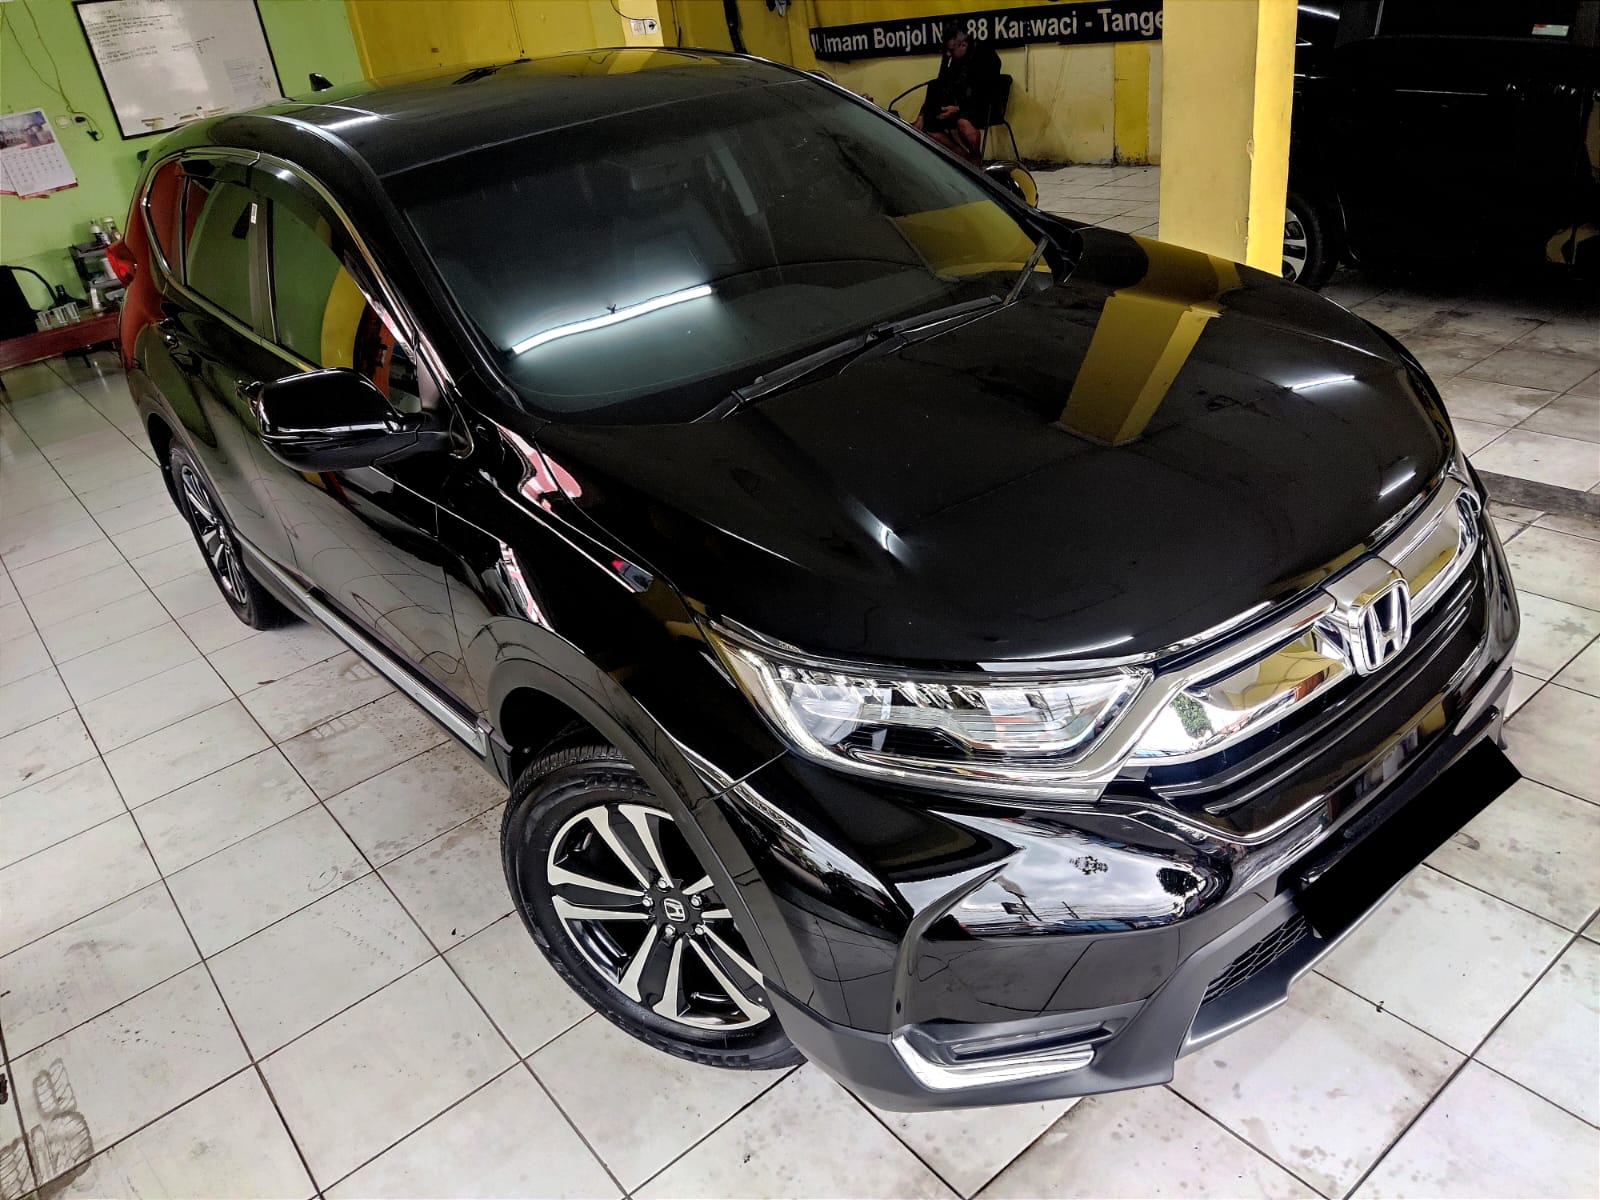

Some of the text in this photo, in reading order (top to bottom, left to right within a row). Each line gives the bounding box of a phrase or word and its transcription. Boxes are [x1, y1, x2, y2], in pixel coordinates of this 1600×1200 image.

[823, 32, 869, 53] Imam
[873, 23, 927, 52] Bonjol
[994, 10, 1077, 40] Karwaci
